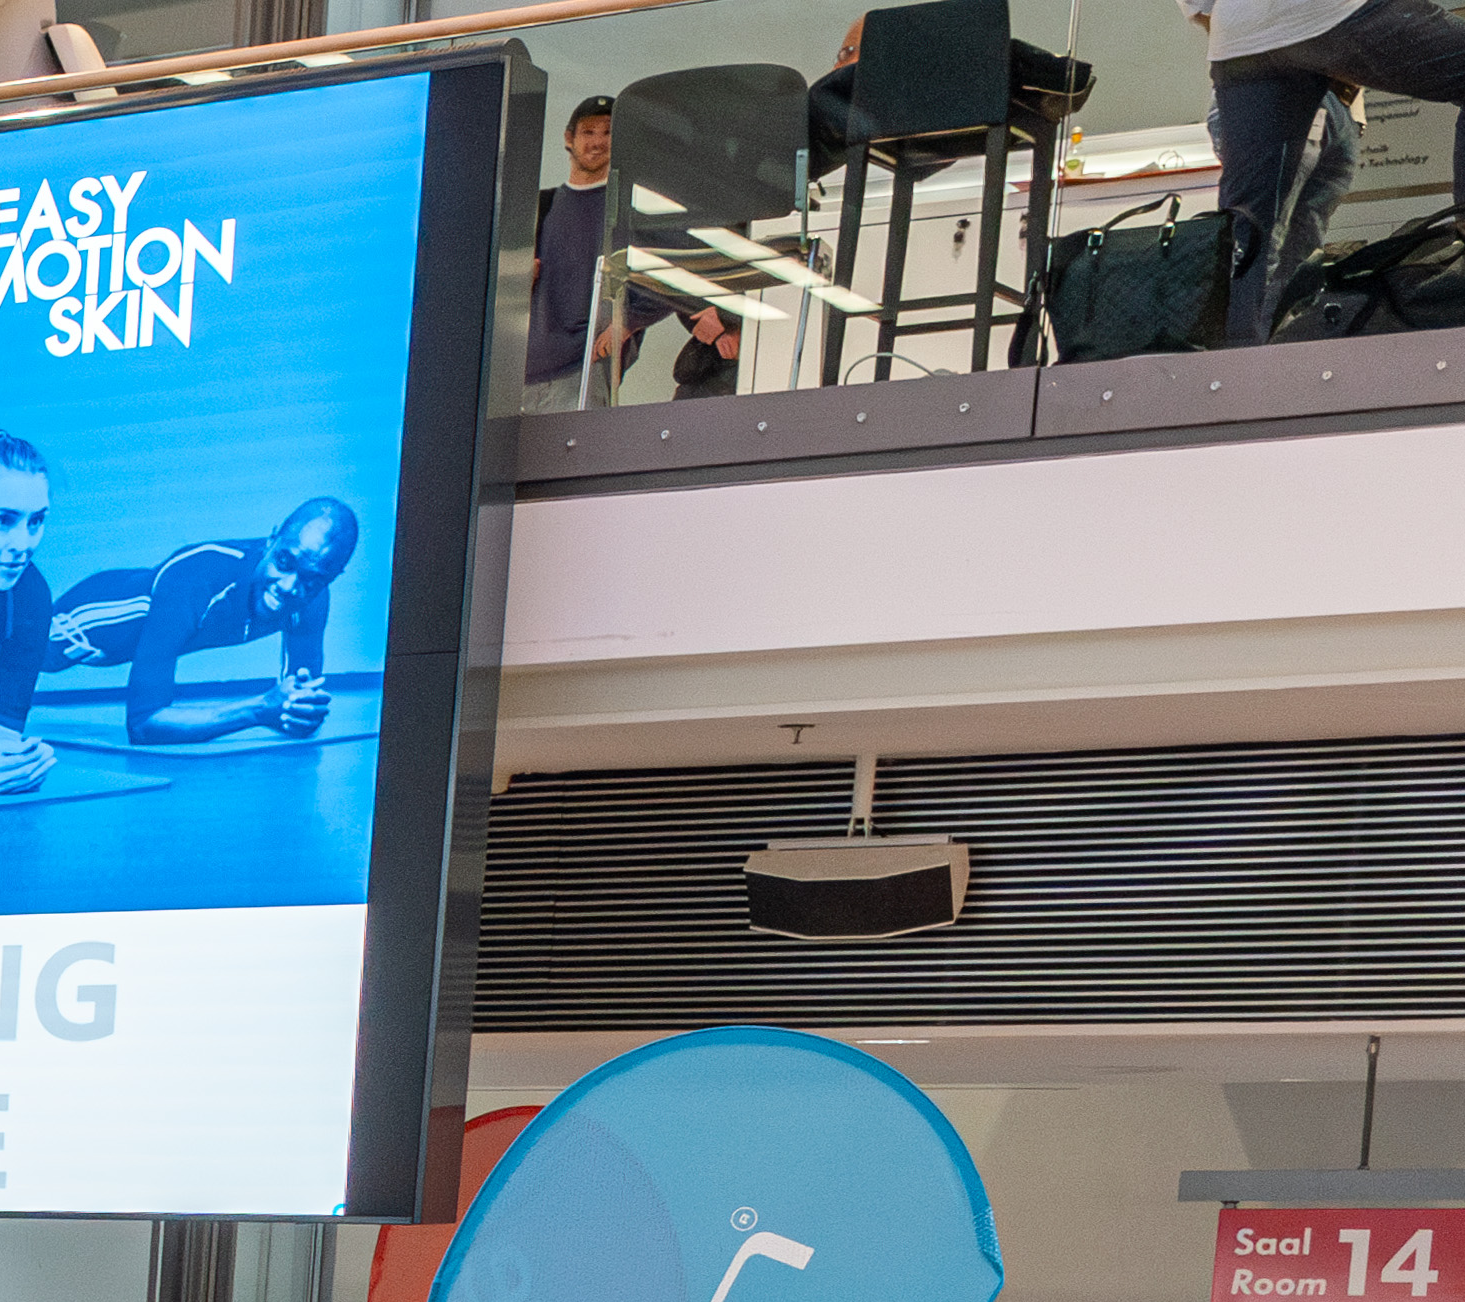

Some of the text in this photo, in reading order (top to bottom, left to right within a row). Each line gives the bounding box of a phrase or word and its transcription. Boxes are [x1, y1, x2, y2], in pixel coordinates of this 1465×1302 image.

[45, 283, 193, 358] SKIN
[1230, 1268, 1328, 1297] Room
[1233, 1227, 1440, 1297] Saal 14
